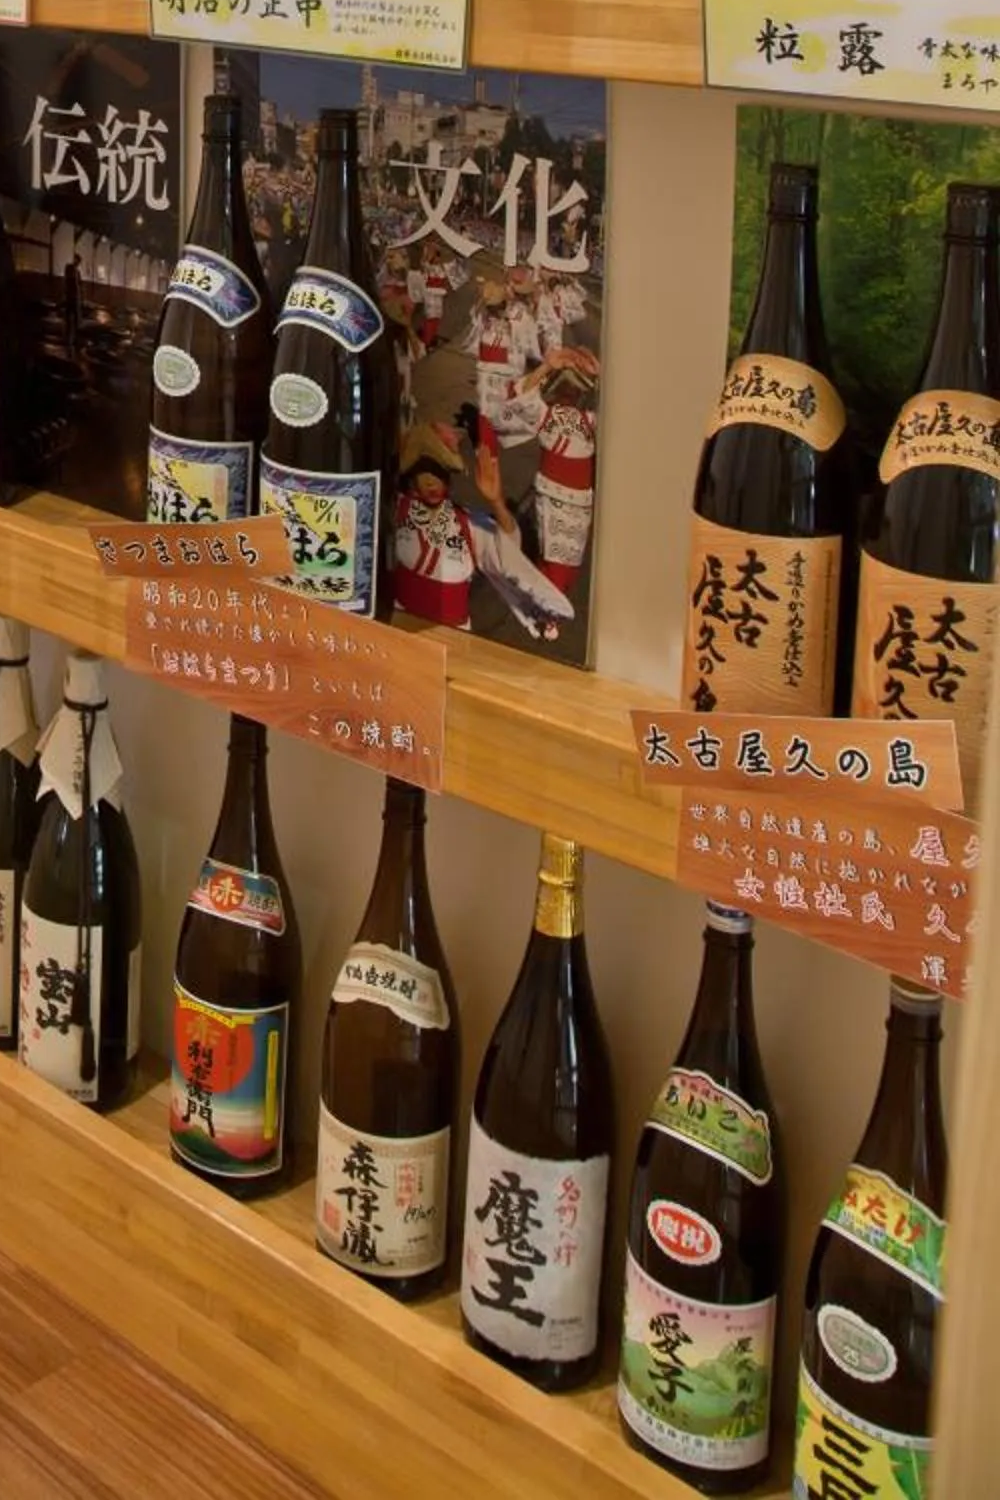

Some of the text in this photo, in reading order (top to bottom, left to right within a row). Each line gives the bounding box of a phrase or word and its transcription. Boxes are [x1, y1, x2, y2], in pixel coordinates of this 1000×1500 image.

[917, 36, 1000, 63] 骨太な味
[22, 96, 171, 212] 伝統
[387, 141, 592, 274] 文化
[95, 531, 261, 566] さつまおはら
[142, 581, 311, 622] 昭和20年代より
[729, 548, 780, 649] 太古
[917, 597, 980, 704] 太古
[307, 713, 433, 757] この焼酎。
[644, 724, 927, 789] 太古屋久の島
[211, 876, 244, 907] 赤
[733, 868, 895, 932] 女性杜氏
[664, 1084, 740, 1134] あいこ
[471, 1170, 548, 1329] 魔王
[647, 1312, 695, 1404] 愛子
